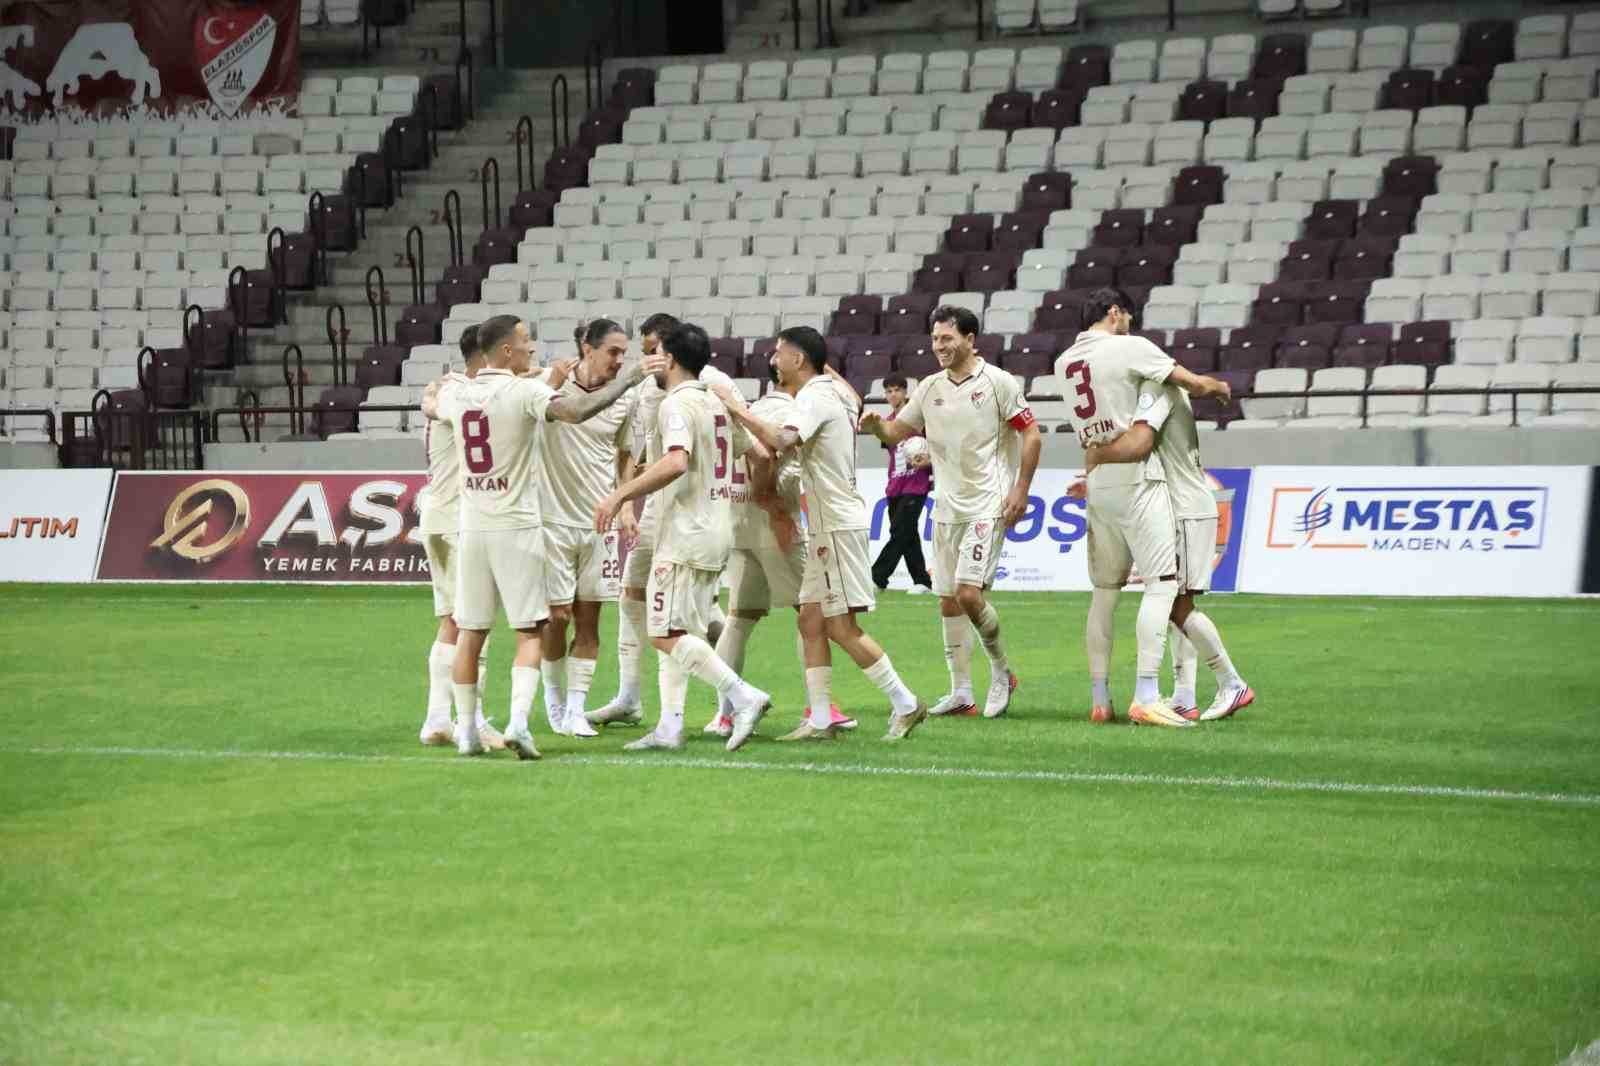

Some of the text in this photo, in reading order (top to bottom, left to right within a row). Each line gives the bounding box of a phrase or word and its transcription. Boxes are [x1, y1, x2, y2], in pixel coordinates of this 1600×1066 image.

[1065, 360, 1096, 419] 3
[462, 410, 493, 474] 8
[714, 415, 728, 479] 5
[466, 477, 508, 491] AKAN
[1342, 499, 1537, 537] MESTAŞ
[973, 544, 983, 561] 6
[1373, 538, 1450, 550] MADEN
[263, 558, 338, 571] YEMEK
[602, 560, 620, 578] 22
[654, 592, 664, 611] 5
